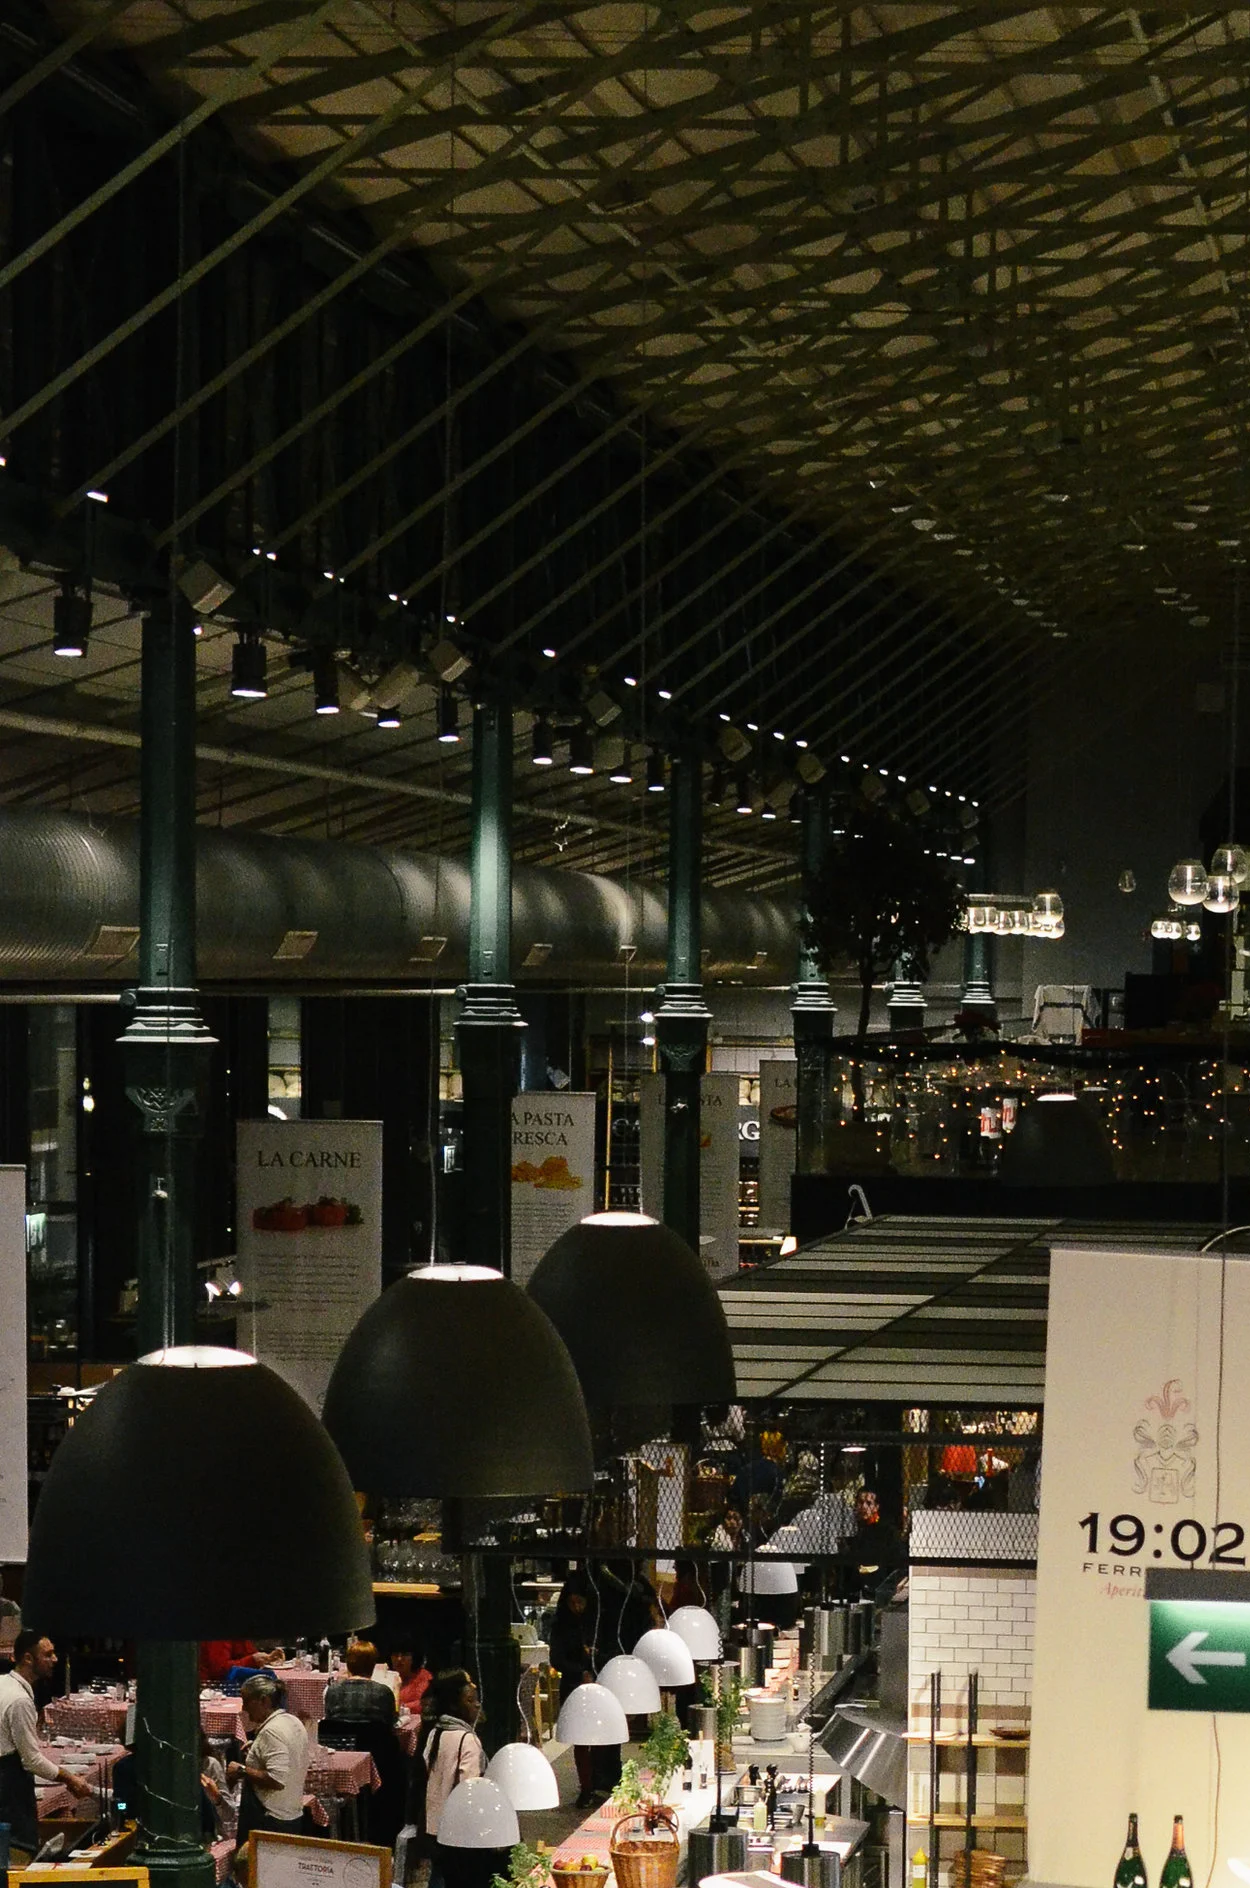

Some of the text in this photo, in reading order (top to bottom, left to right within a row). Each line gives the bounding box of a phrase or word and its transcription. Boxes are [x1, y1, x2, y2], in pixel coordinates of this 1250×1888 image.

[524, 1113, 575, 1127] PASTA
[511, 1131, 567, 1147] RESCA
[258, 1151, 361, 1169] LA CARNE
[1078, 1512, 1246, 1566] 19:02
[1082, 1562, 1143, 1577] FERR
[298, 1862, 334, 1875] TRATTORIA
